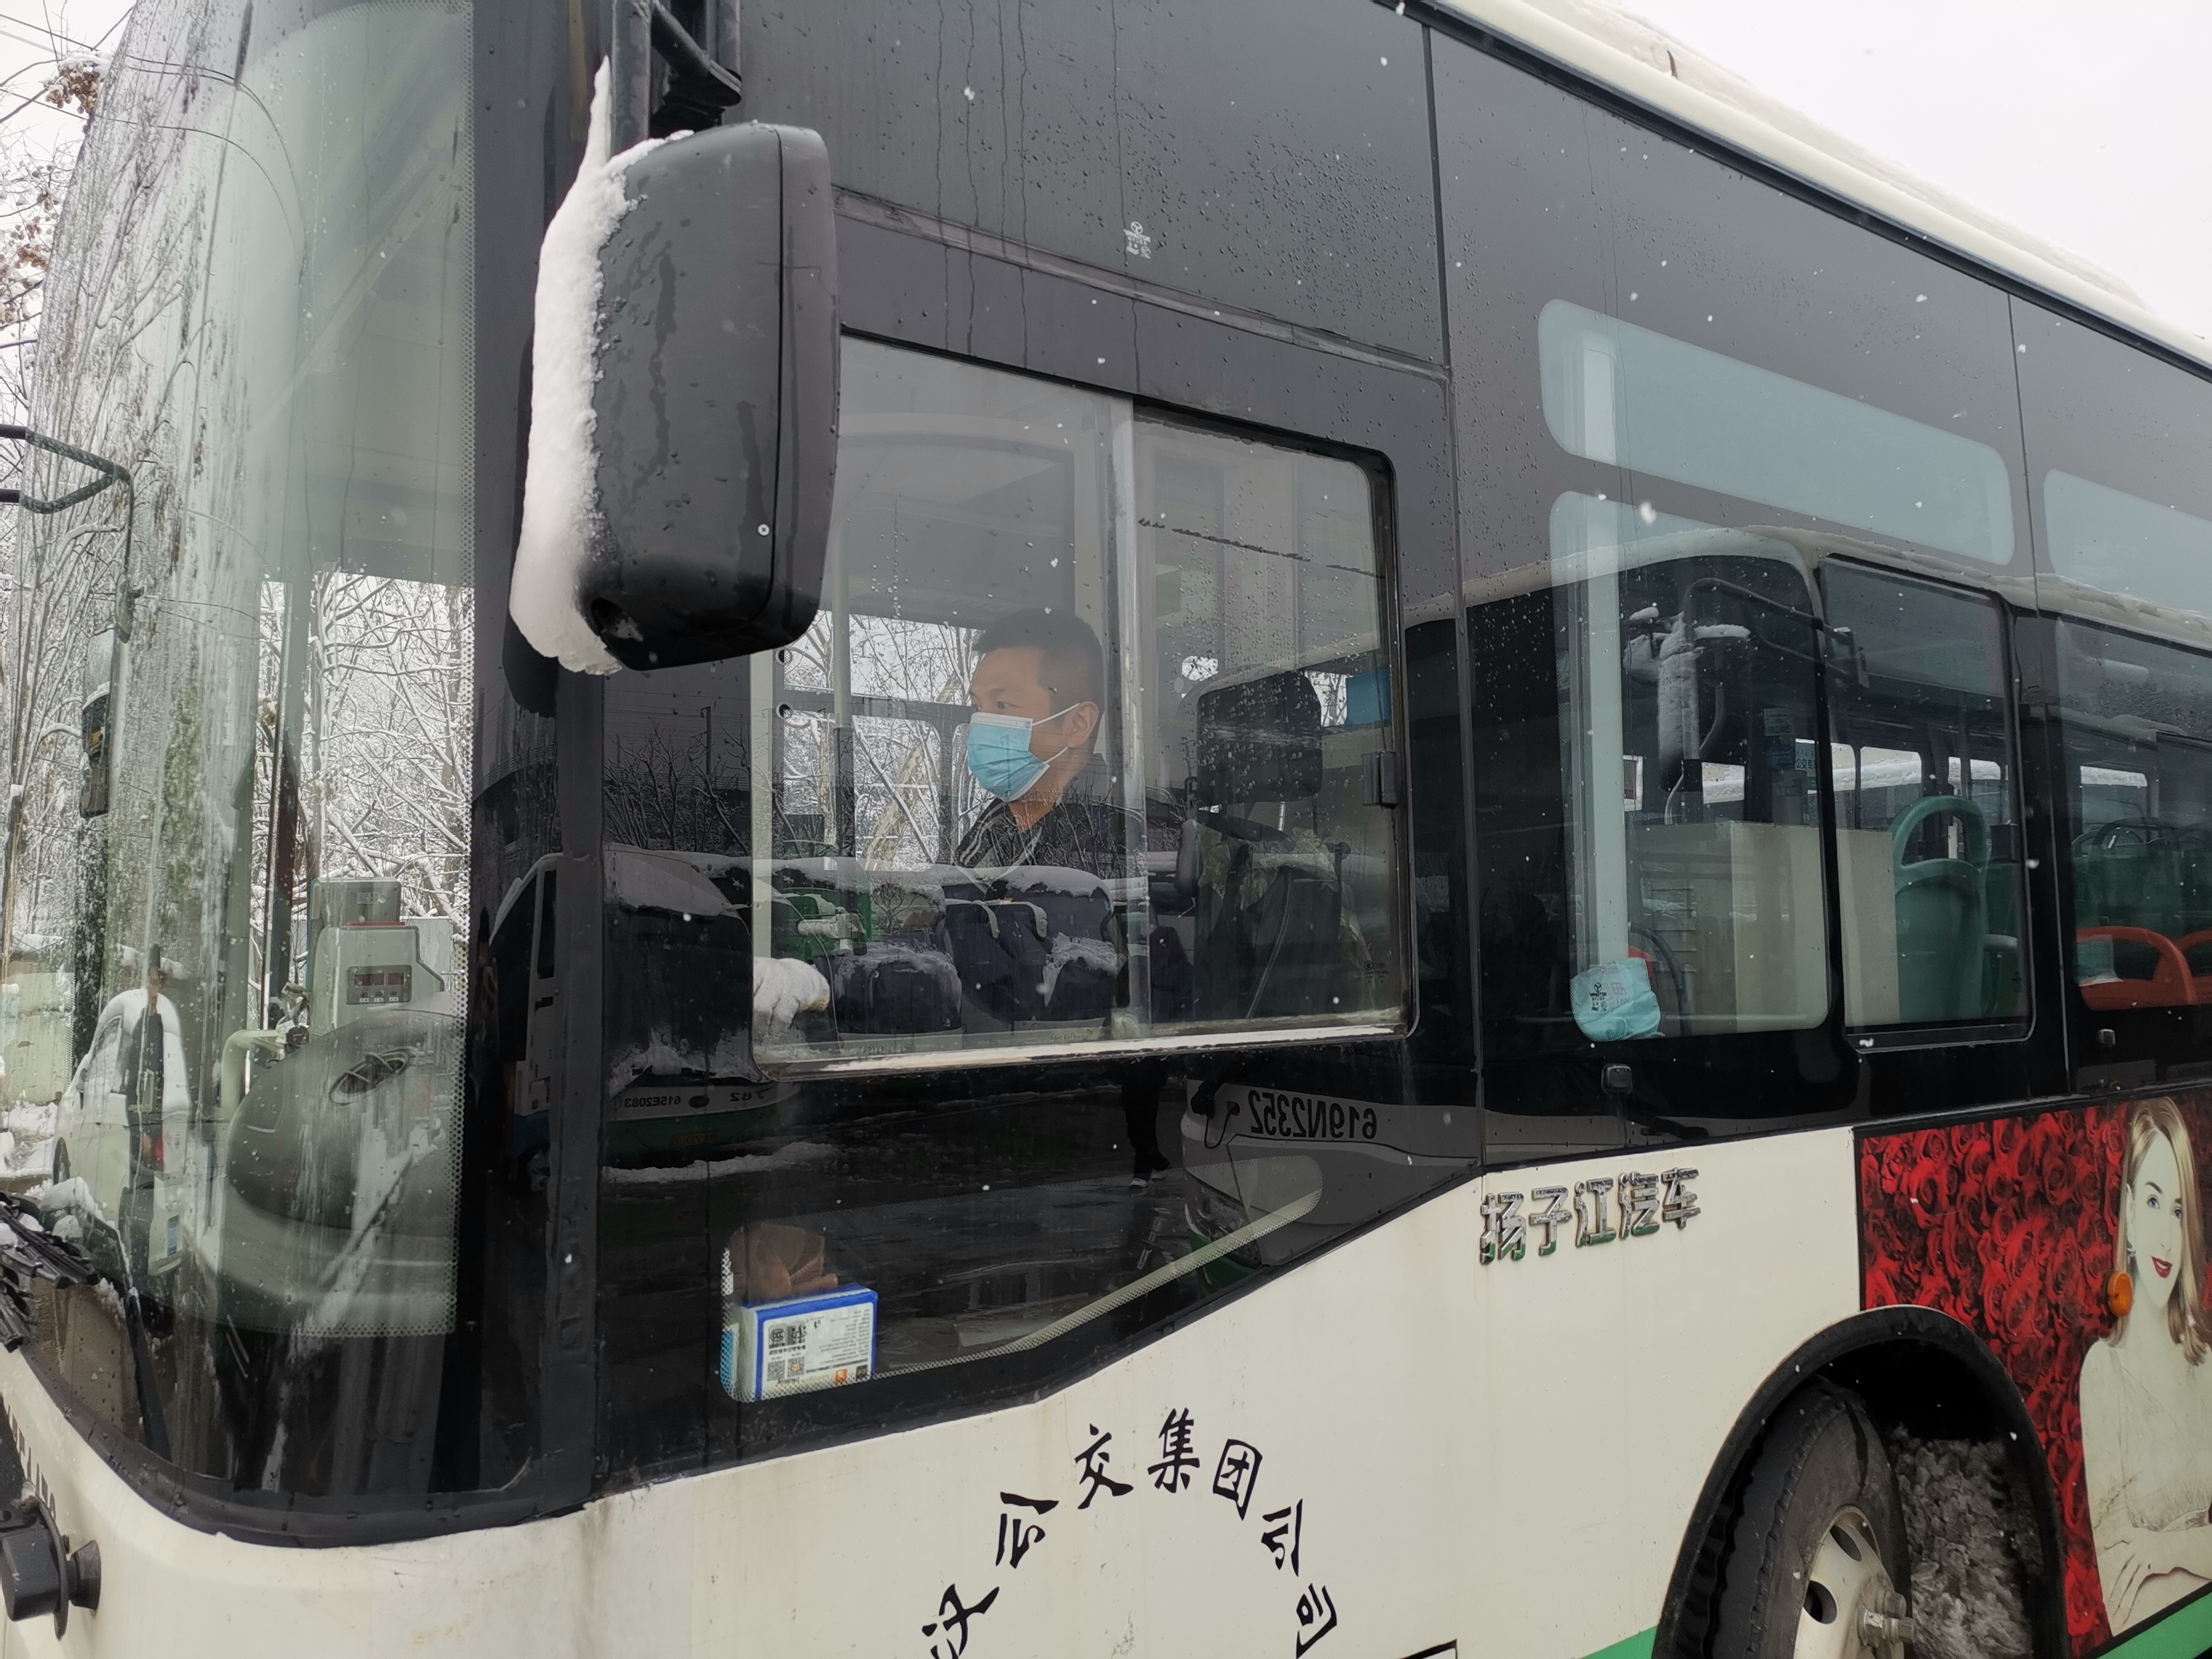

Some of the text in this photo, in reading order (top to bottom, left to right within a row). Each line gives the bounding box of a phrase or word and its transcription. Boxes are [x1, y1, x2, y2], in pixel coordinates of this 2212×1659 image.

[1480, 1167, 1701, 1264] 扬子江汽车
